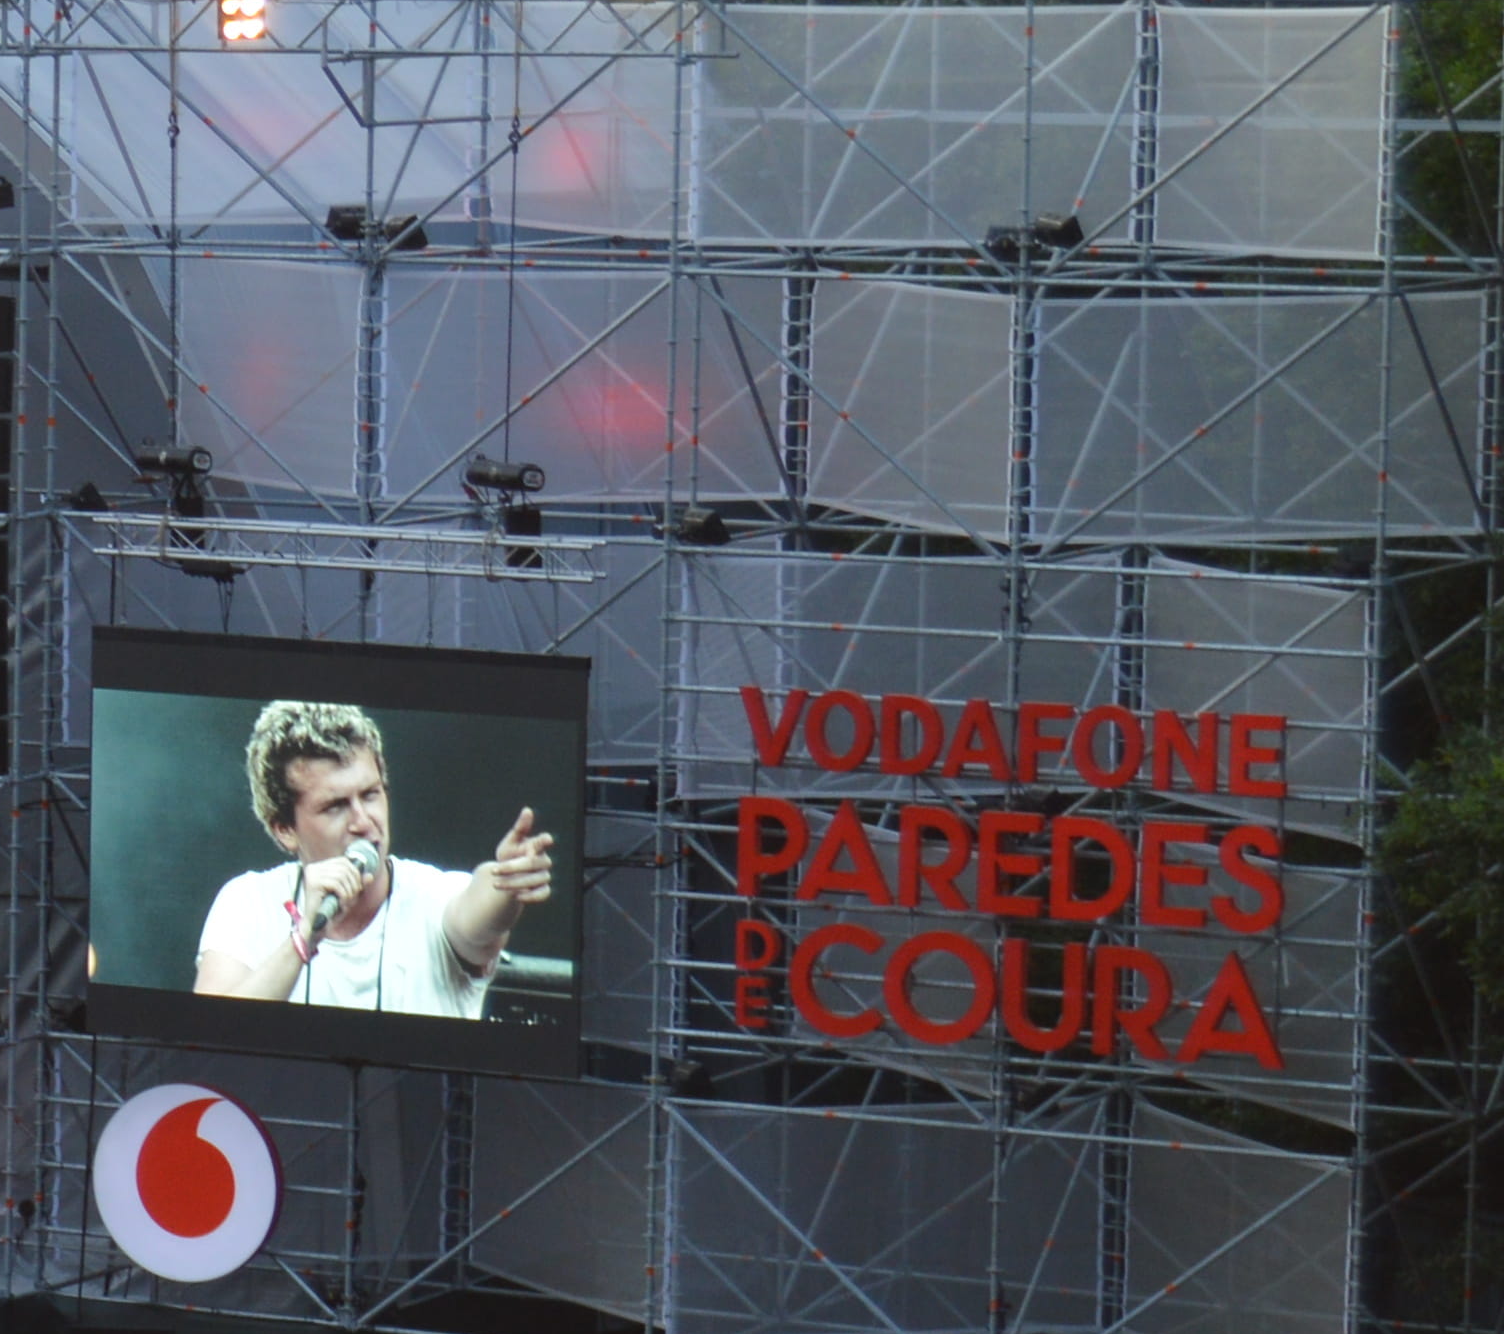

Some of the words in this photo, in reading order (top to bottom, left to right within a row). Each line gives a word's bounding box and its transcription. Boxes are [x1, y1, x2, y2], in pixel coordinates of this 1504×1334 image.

[739, 686, 1288, 799] VODAFONE
[737, 796, 1285, 935] PAREDES
[788, 923, 1284, 1069] COURA
